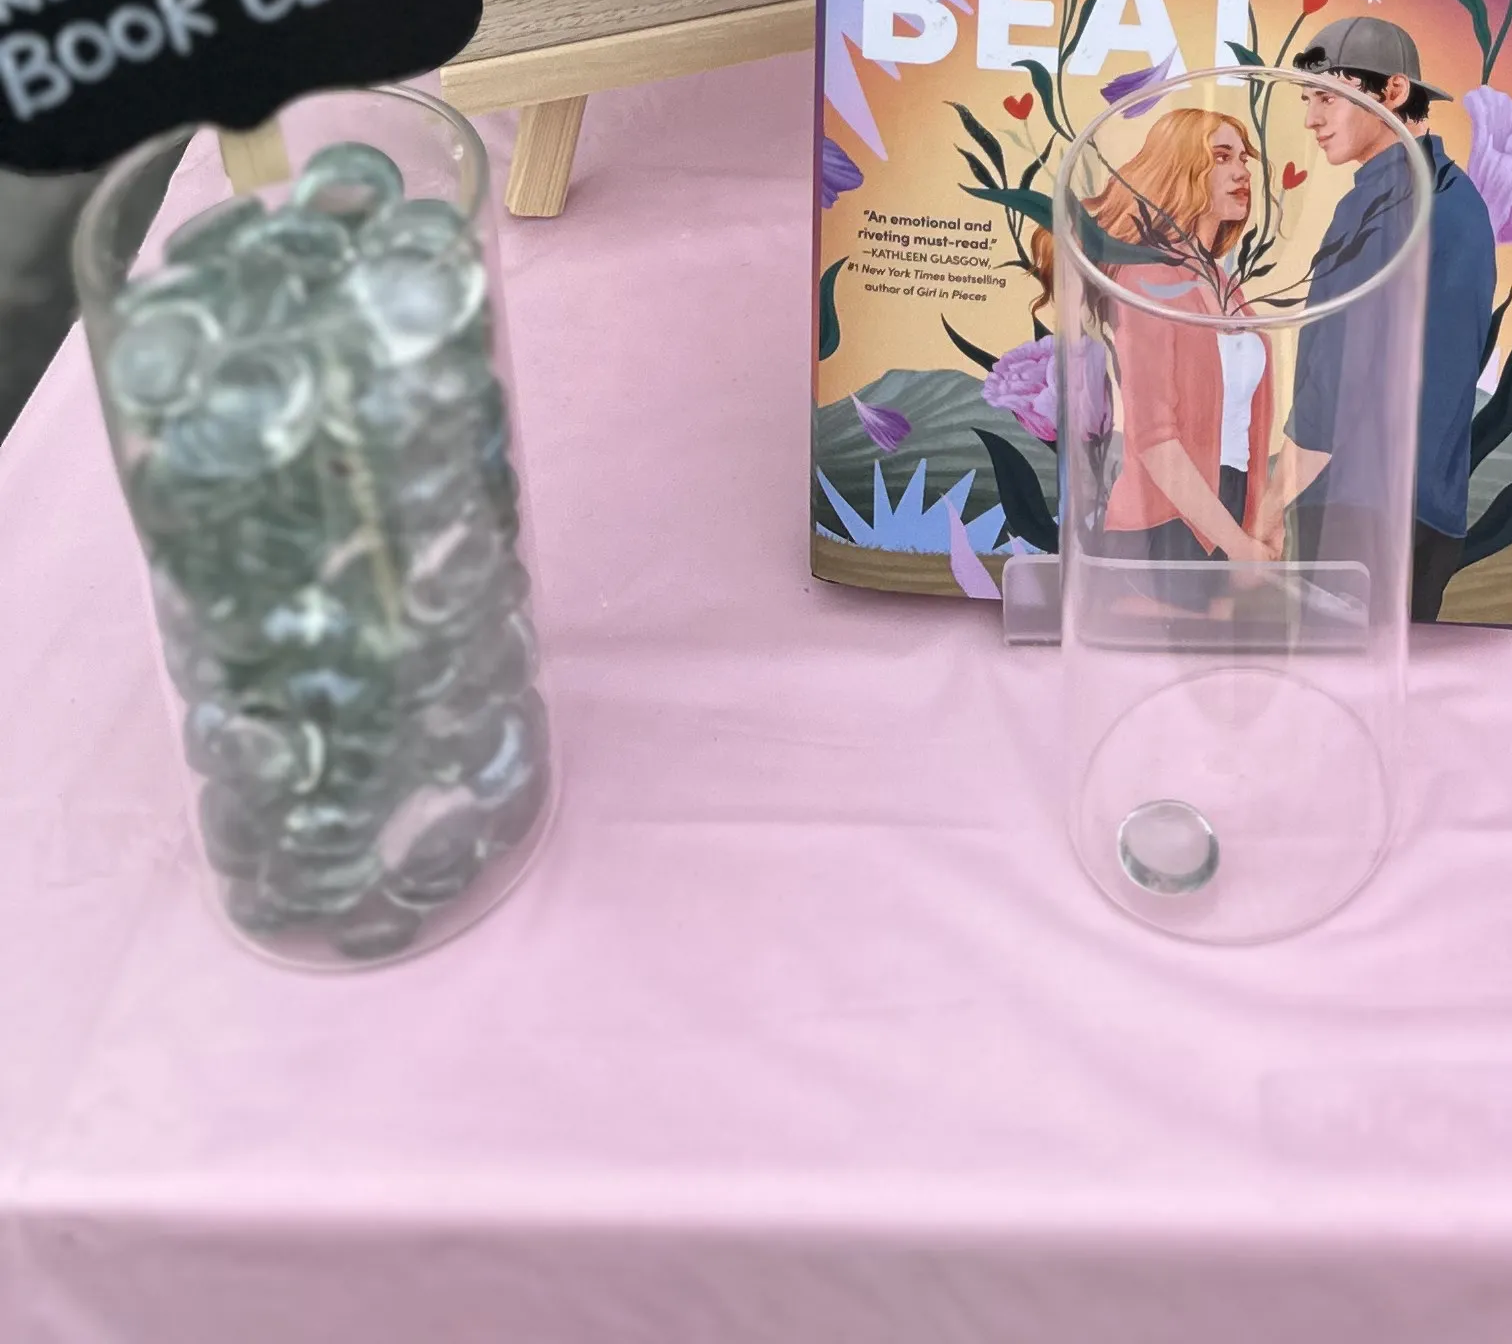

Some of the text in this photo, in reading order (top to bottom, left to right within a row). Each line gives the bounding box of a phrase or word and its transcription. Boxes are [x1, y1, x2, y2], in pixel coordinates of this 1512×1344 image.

[863, 209, 992, 232] “An emotional and
[858, 227, 998, 251] riveting must-read.”
[930, 254, 992, 270] GLASGOW,
[847, 261, 1007, 289] #1 New York Times bestselling
[864, 282, 988, 302] author of Girl in Pieces
